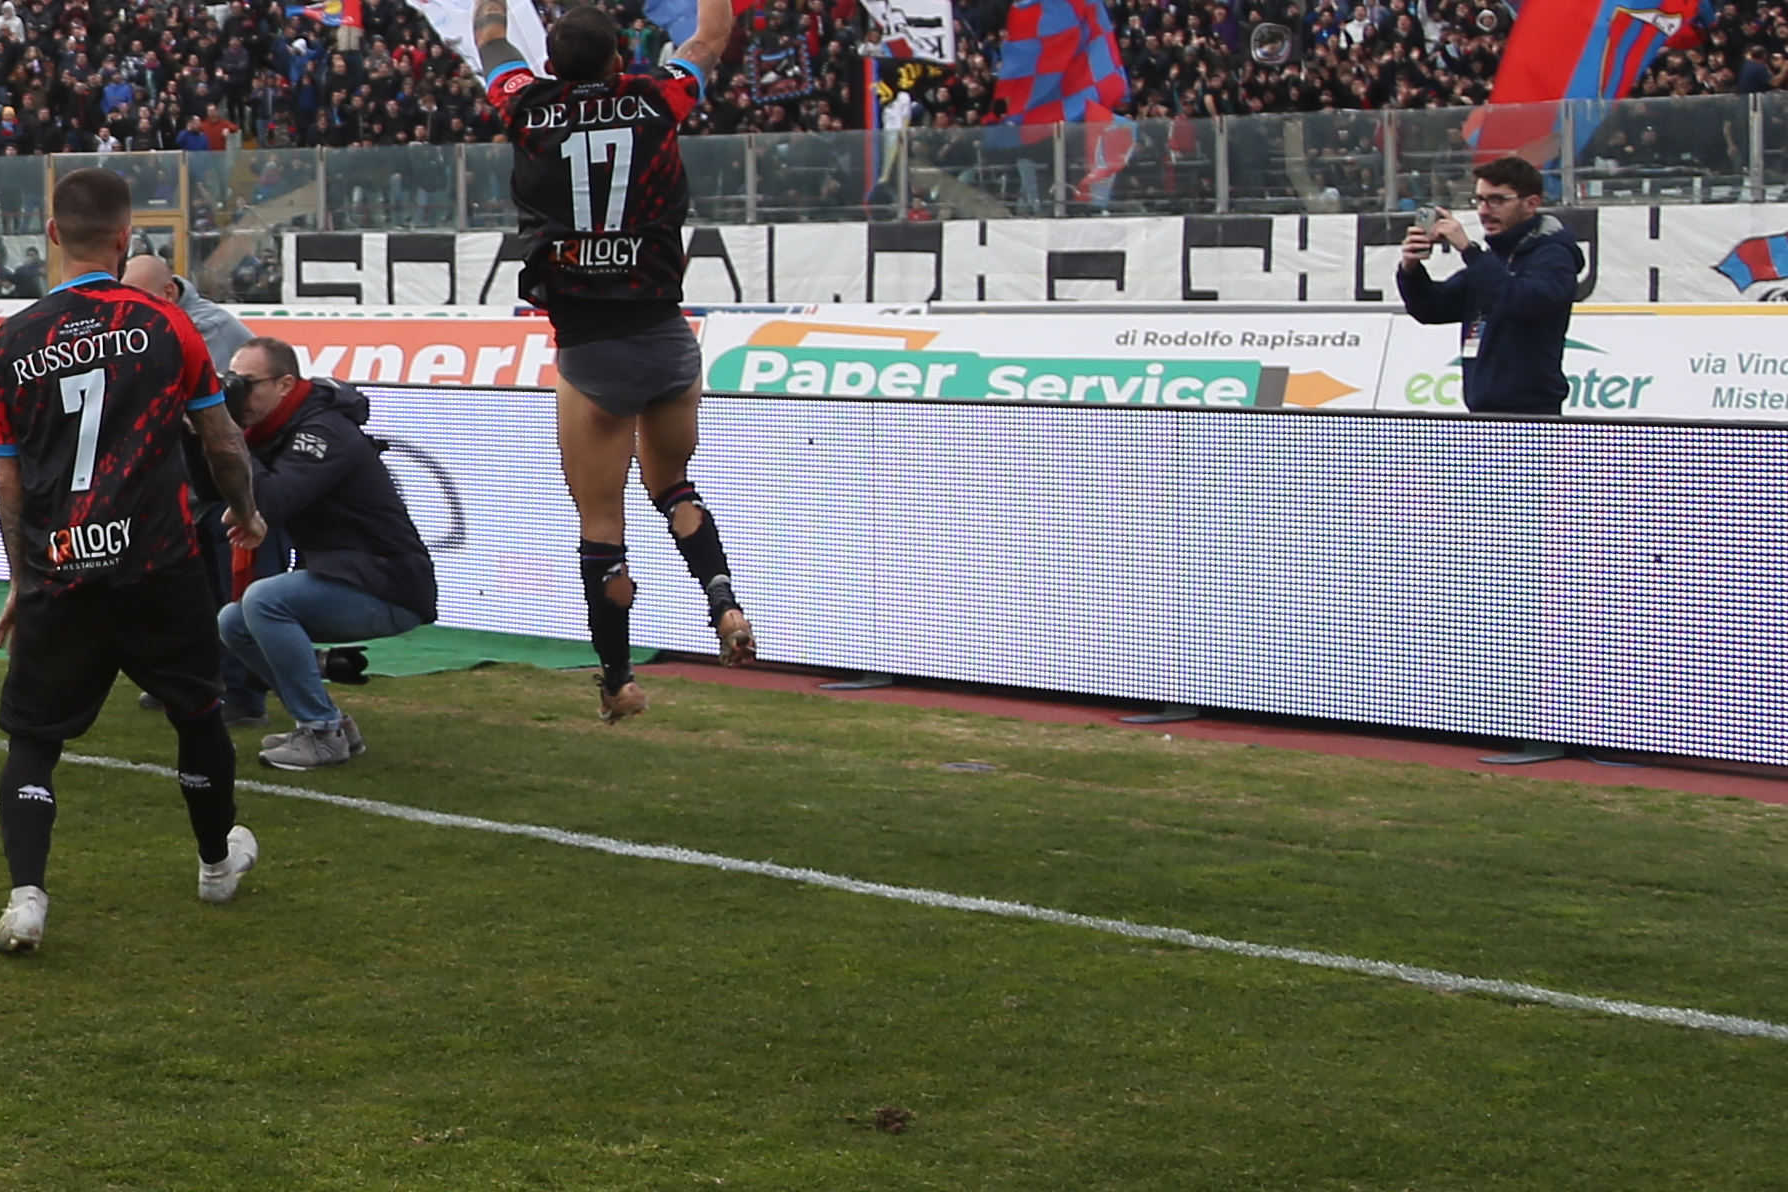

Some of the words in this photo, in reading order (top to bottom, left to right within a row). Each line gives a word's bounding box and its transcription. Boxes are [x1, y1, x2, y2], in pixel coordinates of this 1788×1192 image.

[526, 103, 569, 129] DE
[578, 95, 661, 125] LUCA
[560, 127, 634, 232] 17
[552, 237, 644, 267] TRILOGY
[12, 328, 149, 385] RUSSOTTO
[295, 333, 559, 385] xpert
[1115, 330, 1137, 347] di
[1143, 330, 1233, 347] Rodolfo
[1240, 330, 1361, 350] Rapisarda
[1690, 352, 1727, 374] via
[739, 349, 957, 398] Paper
[984, 363, 1248, 406] Service
[59, 368, 105, 492] 7
